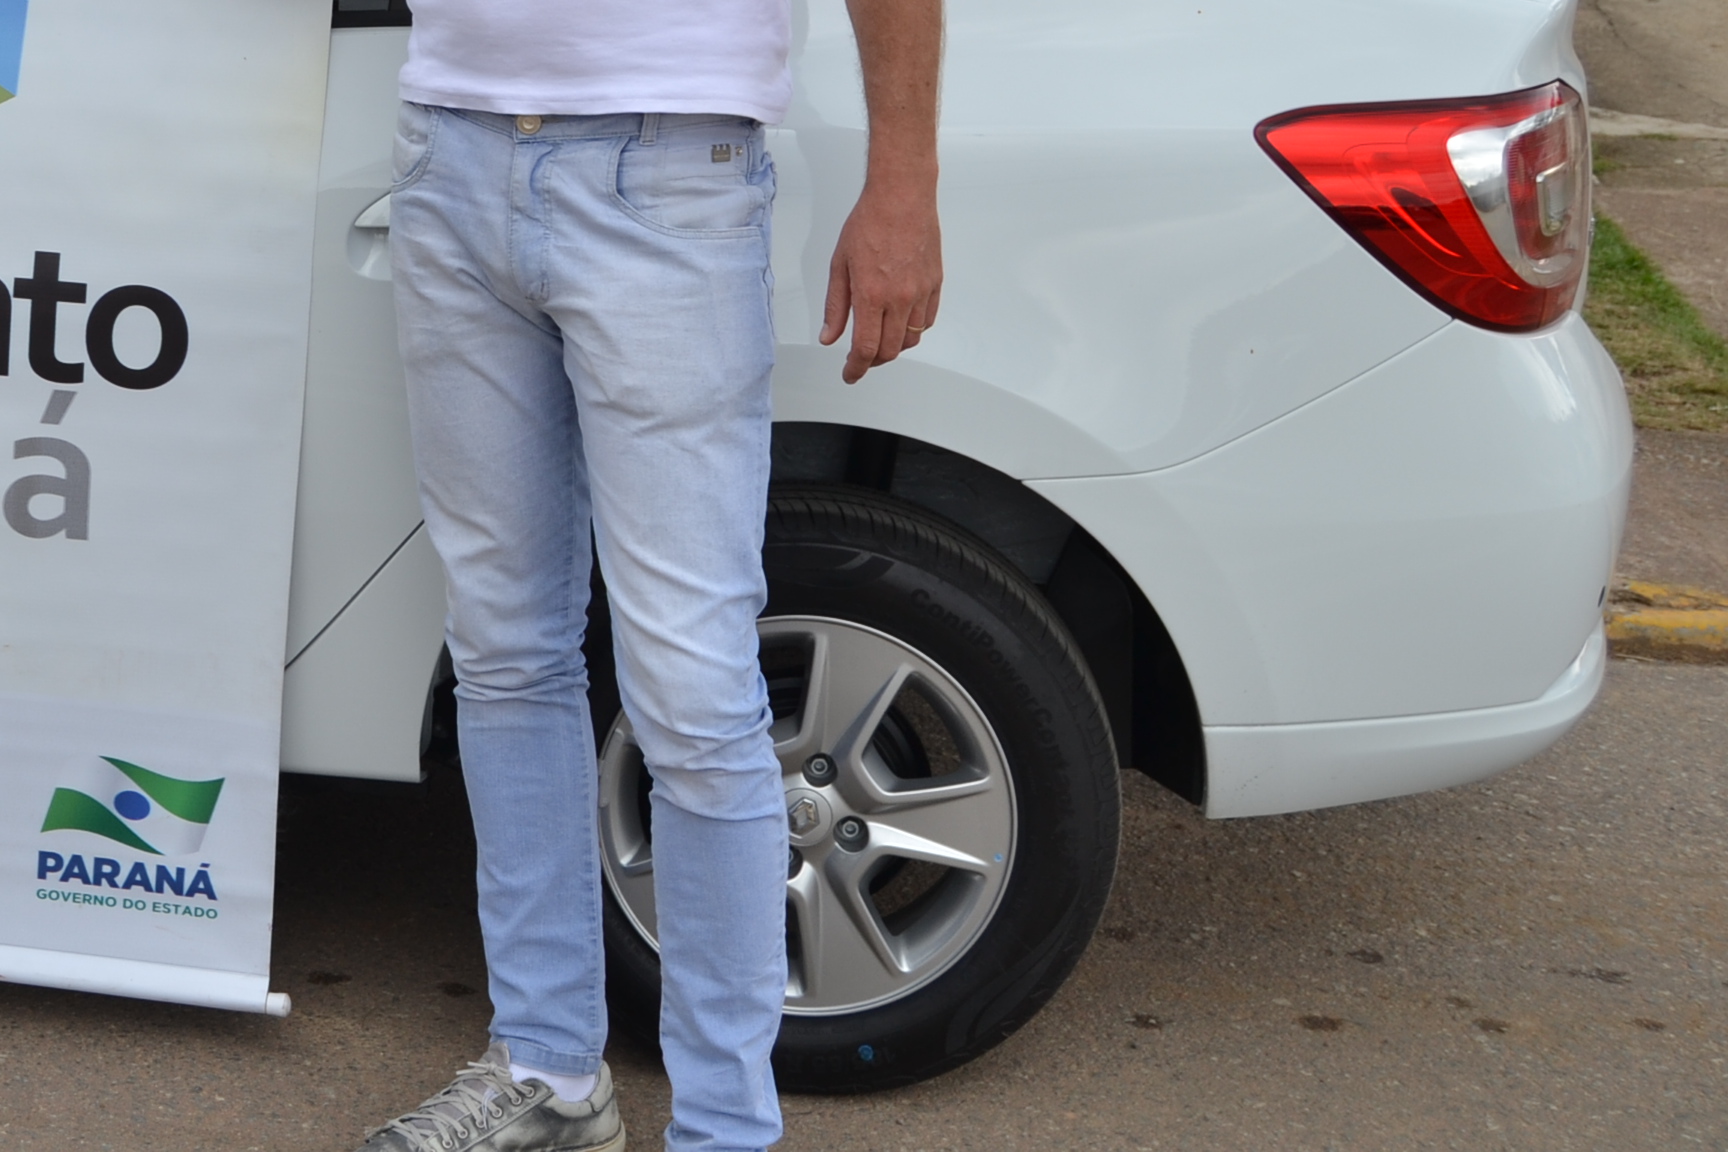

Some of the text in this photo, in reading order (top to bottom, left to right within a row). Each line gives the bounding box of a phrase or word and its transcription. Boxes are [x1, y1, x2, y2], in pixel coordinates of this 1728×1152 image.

[36, 849, 218, 901] PARANÁ
[35, 888, 219, 920] GOVERNO DO ESTADO
